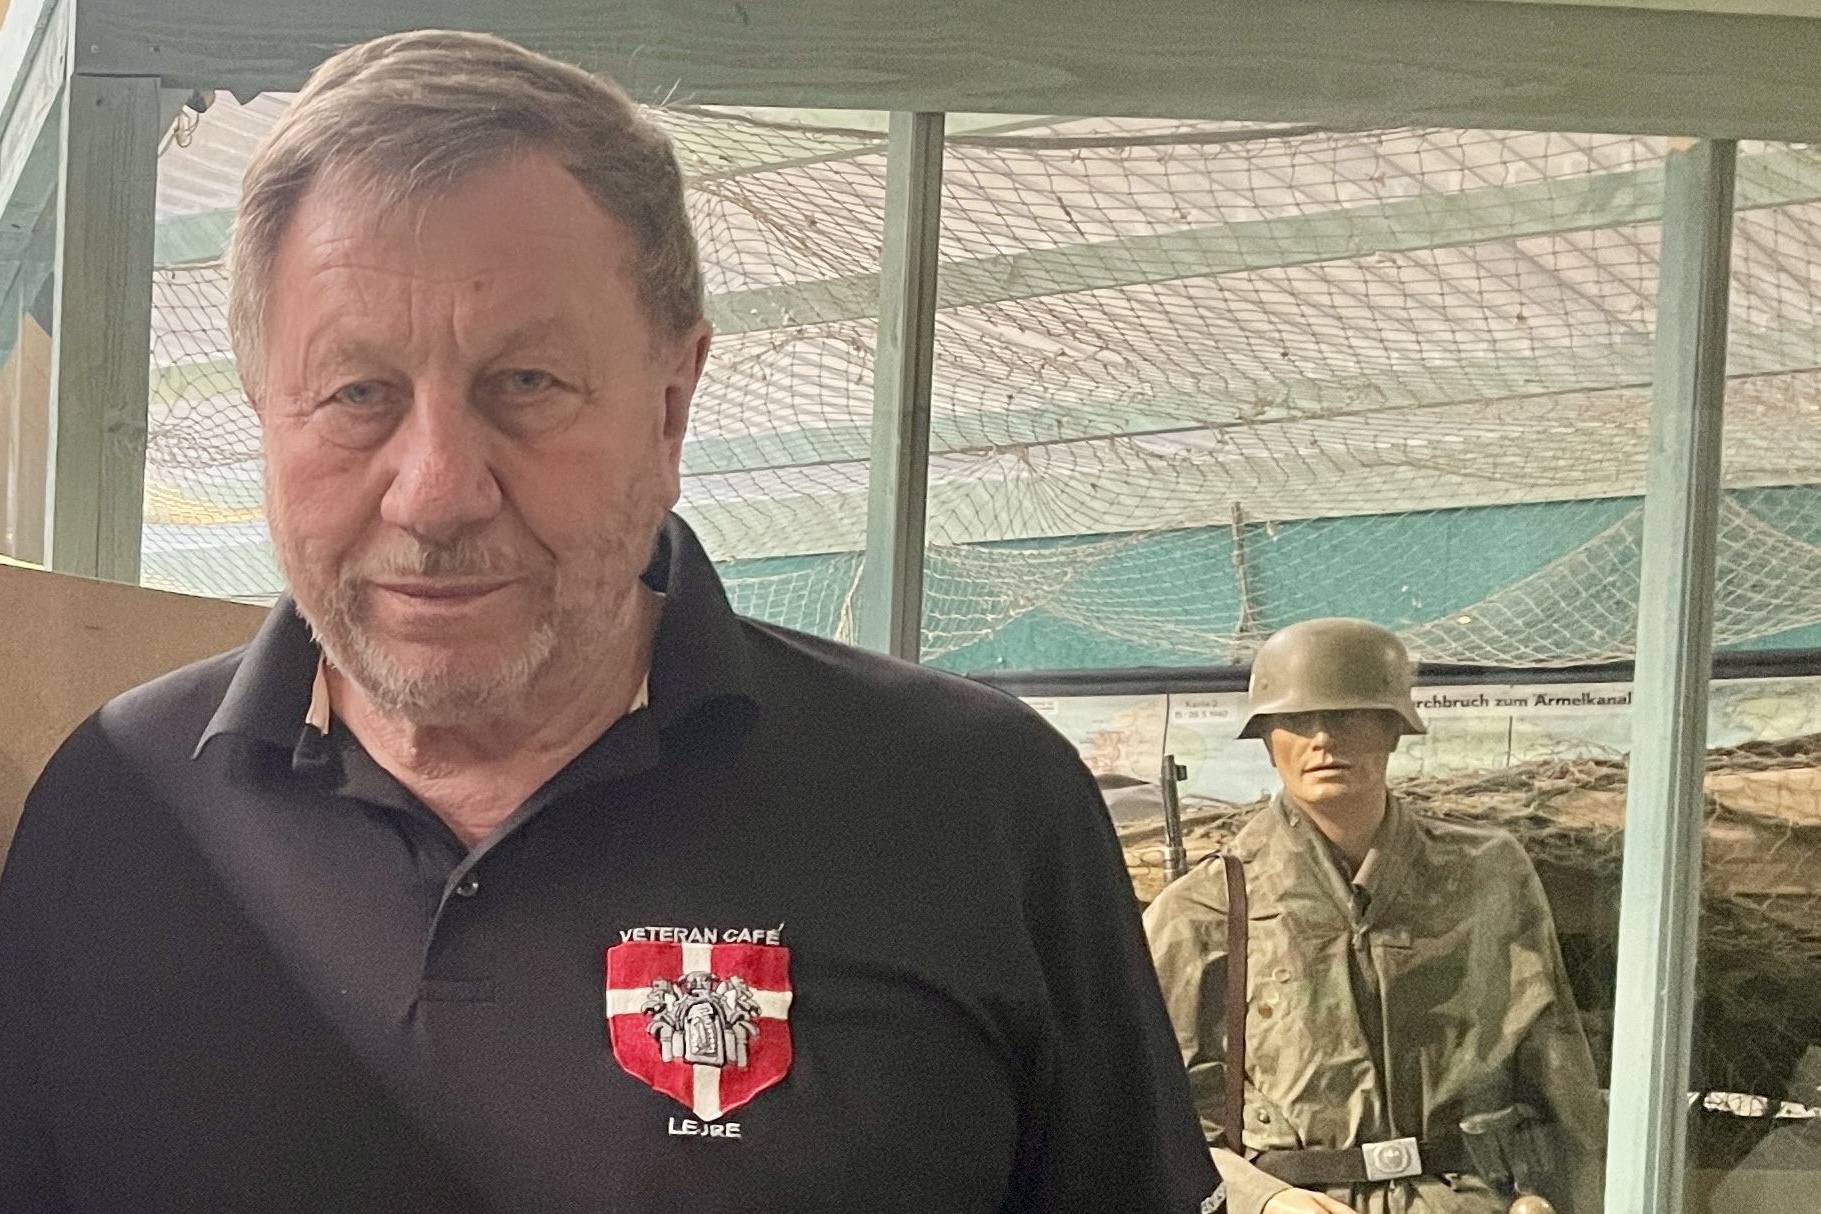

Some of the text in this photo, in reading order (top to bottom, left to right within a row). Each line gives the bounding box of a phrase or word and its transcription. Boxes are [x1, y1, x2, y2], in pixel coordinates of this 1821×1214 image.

[1413, 692, 1633, 709] rchbruch zum Ärmelkanal
[619, 926, 718, 944] VETERAN
[668, 1117, 742, 1138] LEJRE
